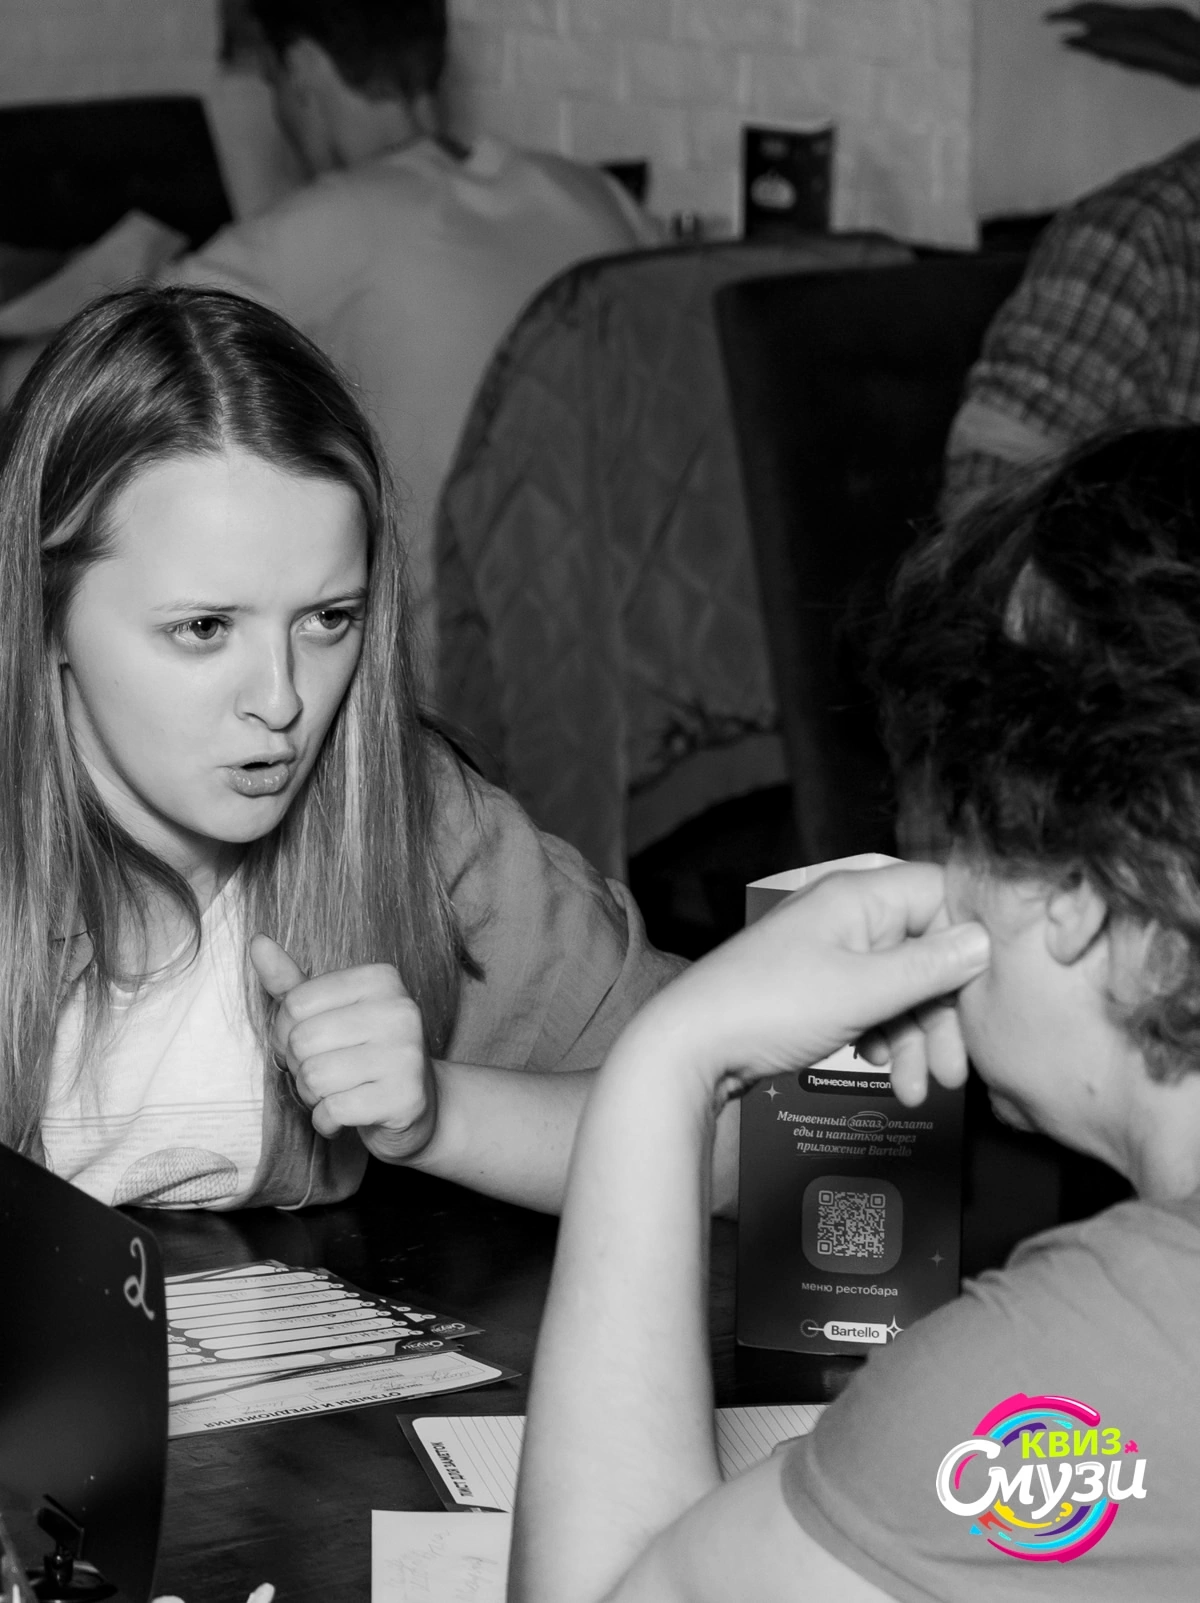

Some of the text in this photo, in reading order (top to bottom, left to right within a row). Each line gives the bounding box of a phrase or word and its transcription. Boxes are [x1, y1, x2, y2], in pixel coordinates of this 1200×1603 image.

[807, 1075, 855, 1088] Принесем
[869, 1081, 891, 1089] стол
[777, 1110, 934, 1130] Мгновенный заказ, оплата
[793, 1127, 814, 1138] еды
[825, 1131, 884, 1142] напитков
[886, 1134, 917, 1144] через
[796, 1142, 867, 1155] приложение
[801, 1282, 899, 1298] меню рестобара
[831, 1325, 880, 1339] Bartello
[337, 1392, 401, 1406] ОТЗЫВЫ
[204, 1404, 320, 1429] ПРЕДЛОЖЕНИЯ
